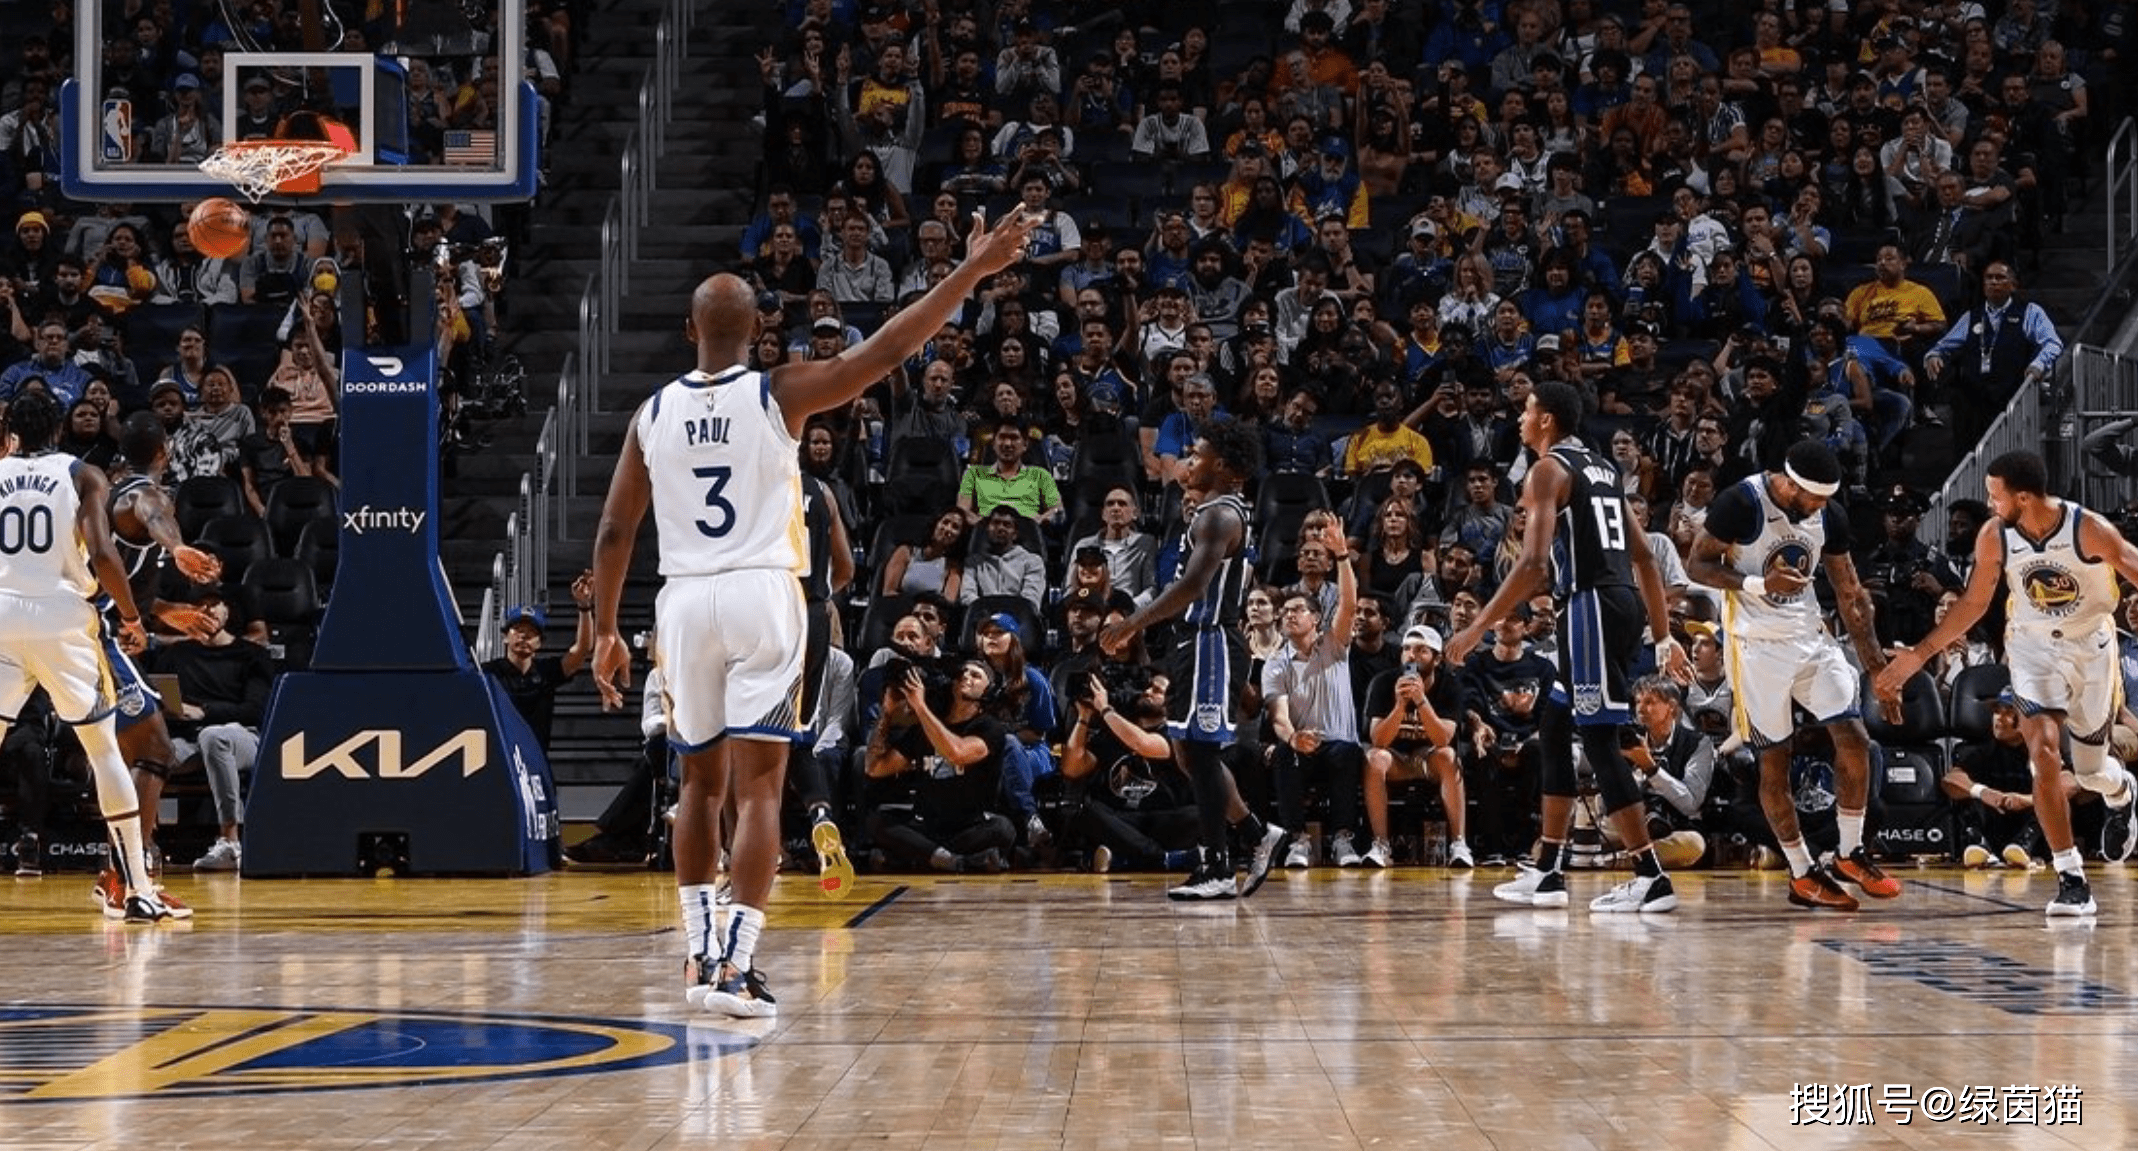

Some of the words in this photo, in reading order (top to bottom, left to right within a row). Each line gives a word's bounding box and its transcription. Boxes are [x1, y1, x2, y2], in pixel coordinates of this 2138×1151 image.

[345, 382, 427, 393] DOORDASH
[685, 417, 730, 446] PAUL
[0, 474, 58, 499] KUMINGA
[692, 465, 736, 538] 3
[0, 504, 54, 555] 00
[343, 504, 427, 534] xfinity
[1590, 496, 1626, 551] 13
[281, 729, 488, 779] KIA
[1877, 829, 1925, 841] HASE
